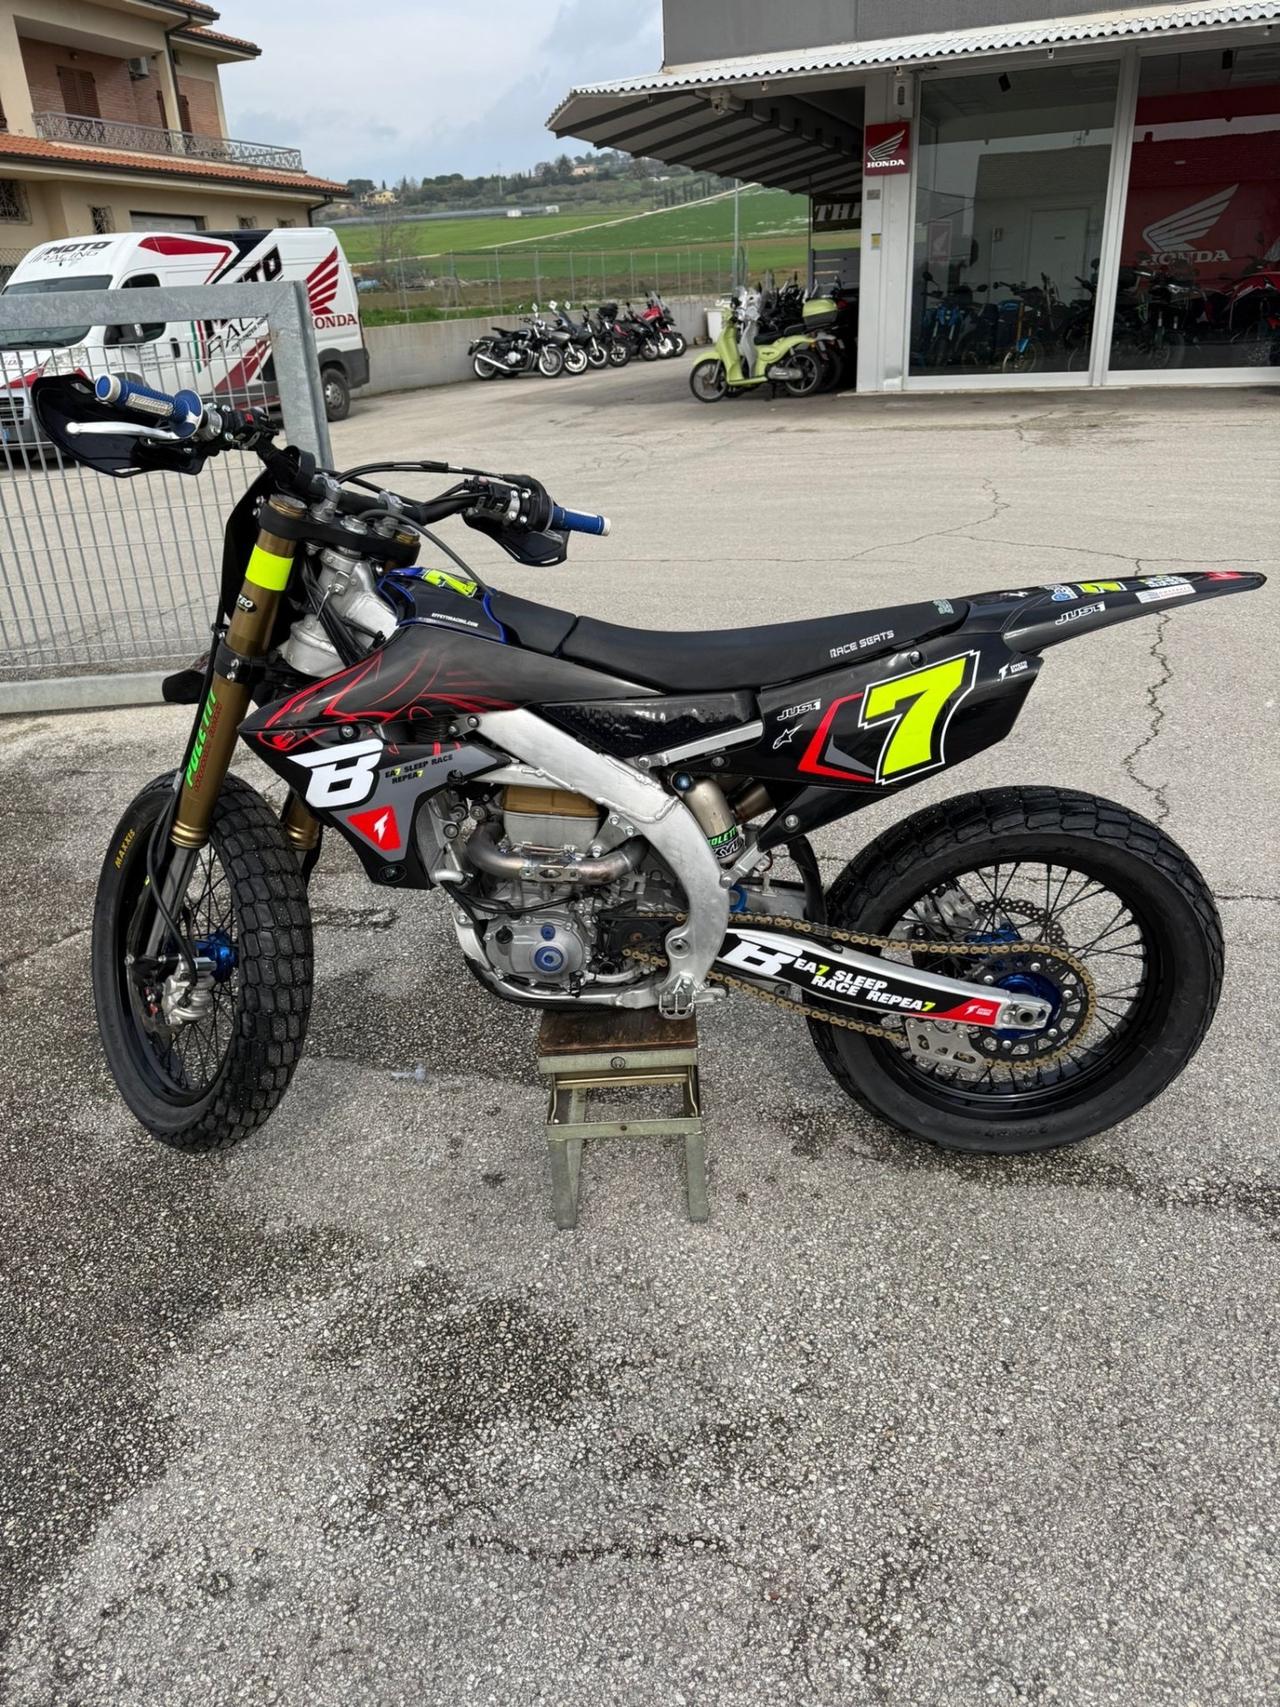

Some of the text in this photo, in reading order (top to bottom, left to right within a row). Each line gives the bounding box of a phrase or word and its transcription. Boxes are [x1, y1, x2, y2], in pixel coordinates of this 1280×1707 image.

[866, 159, 905, 168] HONDA
[45, 241, 113, 255] MOTO
[313, 314, 358, 330] ONDA
[829, 629, 895, 659] RACE SEATS
[858, 650, 979, 785] 7
[403, 760, 429, 773] SLEEP
[431, 753, 453, 765] RACE
[114, 828, 136, 869] MAXXIS
[811, 975, 860, 996] RACE
[832, 970, 888, 990] SLEEP
